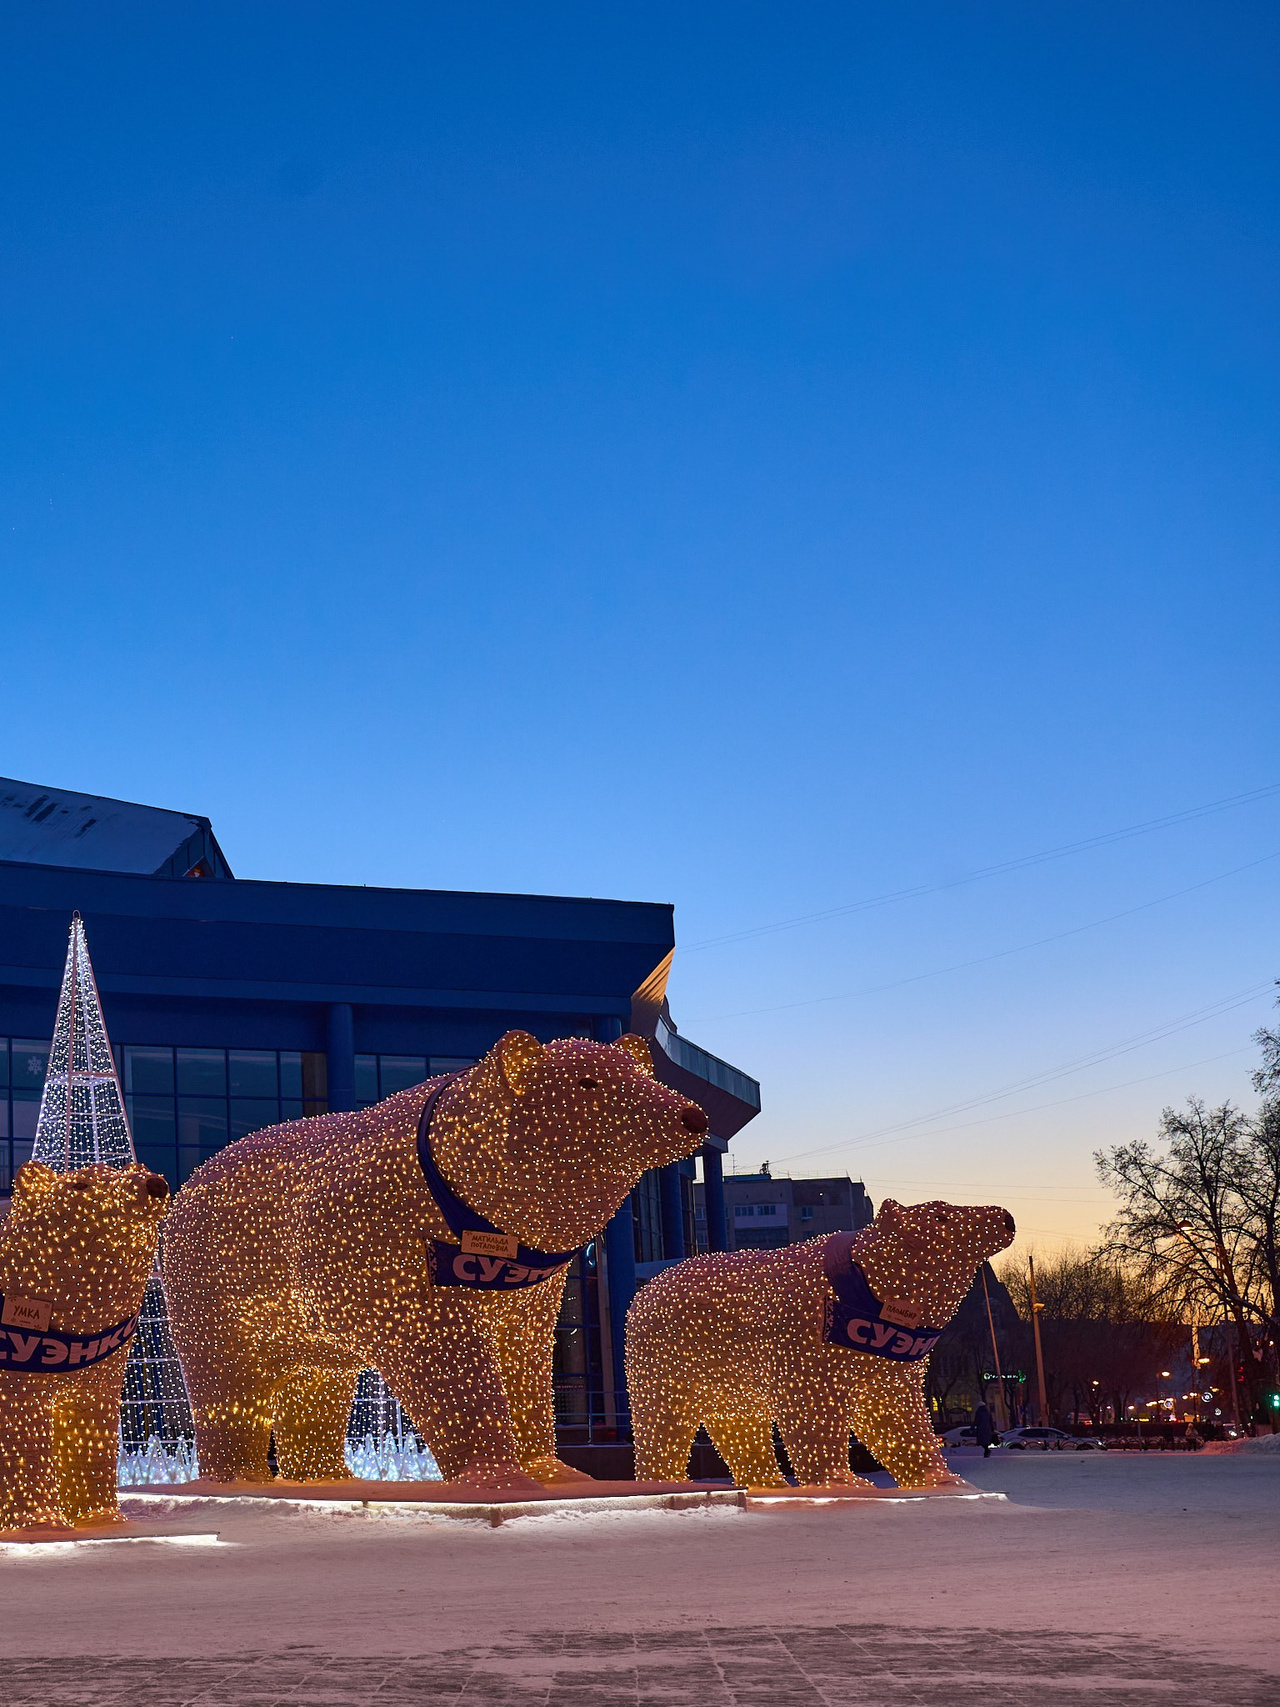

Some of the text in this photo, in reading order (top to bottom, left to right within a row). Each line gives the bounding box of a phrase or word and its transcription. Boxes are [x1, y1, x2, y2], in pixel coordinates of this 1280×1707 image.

[471, 1234, 509, 1246] МАТИЛЬДА
[452, 1254, 568, 1283] СУЭН
[13, 1305, 40, 1320] УМКА
[886, 1304, 917, 1320] ПЛОМБИР
[846, 1318, 941, 1356] СУЭН
